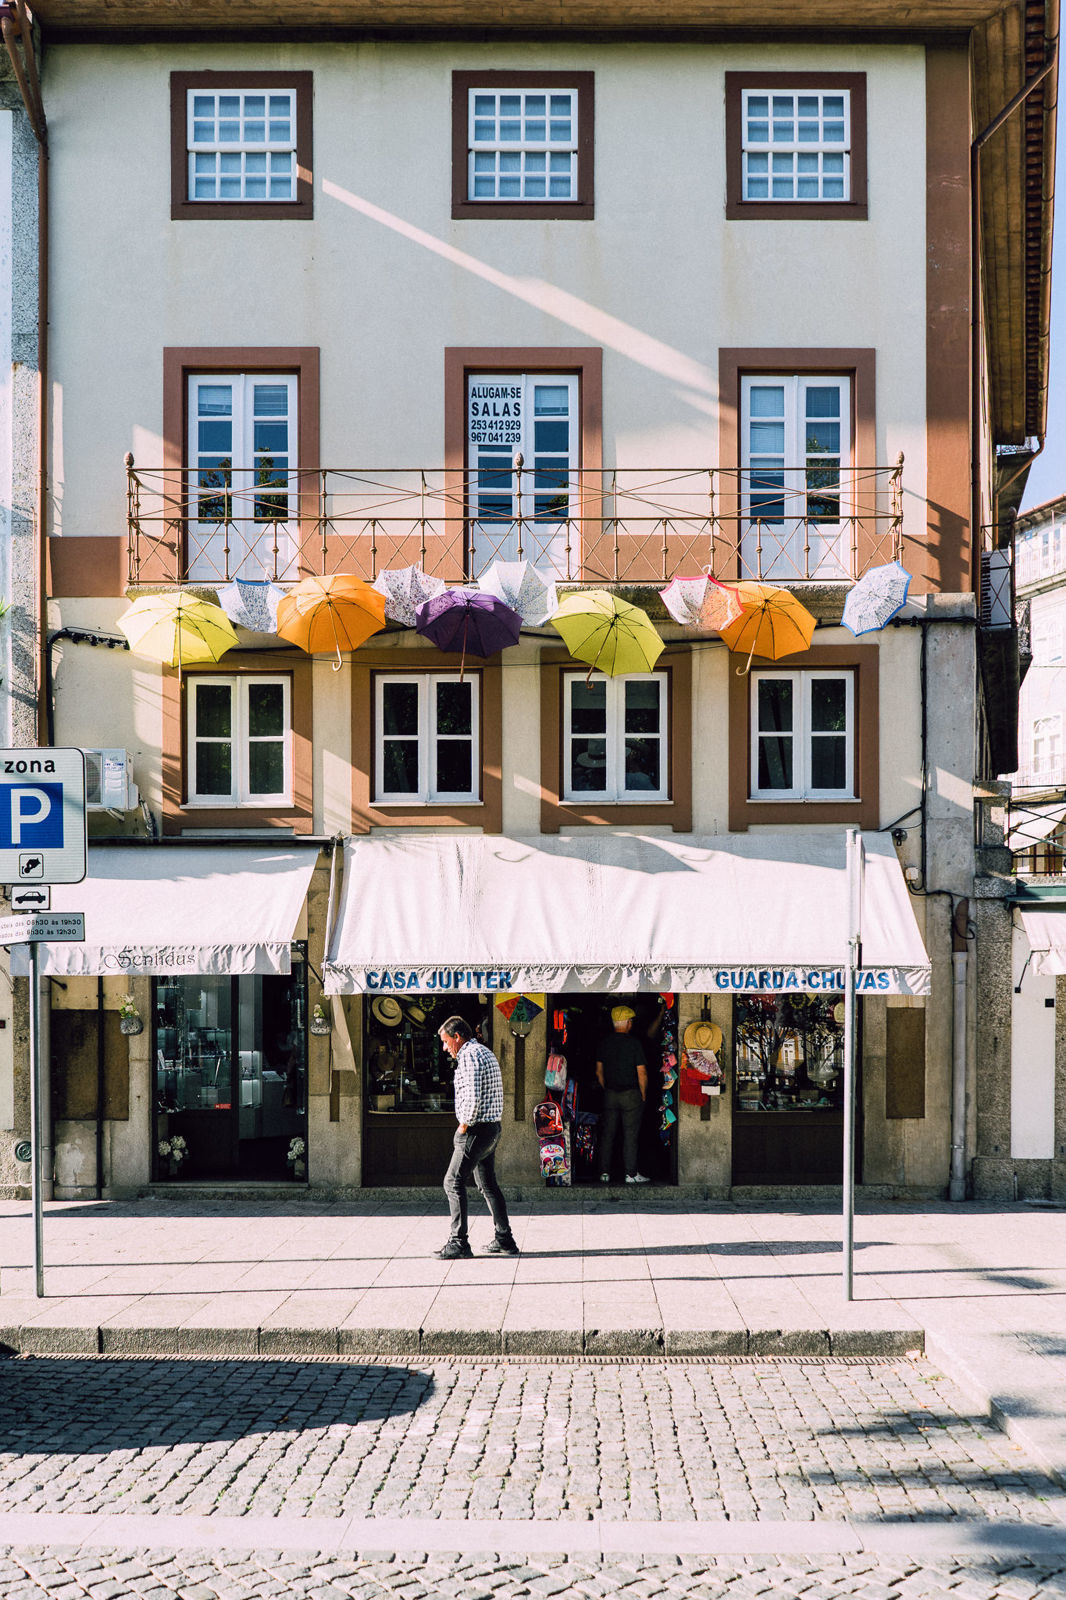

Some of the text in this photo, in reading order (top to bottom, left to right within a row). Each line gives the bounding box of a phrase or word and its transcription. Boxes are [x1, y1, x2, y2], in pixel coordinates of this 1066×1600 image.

[471, 387, 521, 399] ALUGAM-SE
[471, 402, 521, 417] SALAS
[471, 420, 521, 430] 253 412 929
[471, 432, 521, 443] 967 041 239
[4, 759, 56, 774] zona
[10, 788, 52, 845] P
[366, 971, 420, 989] CASA
